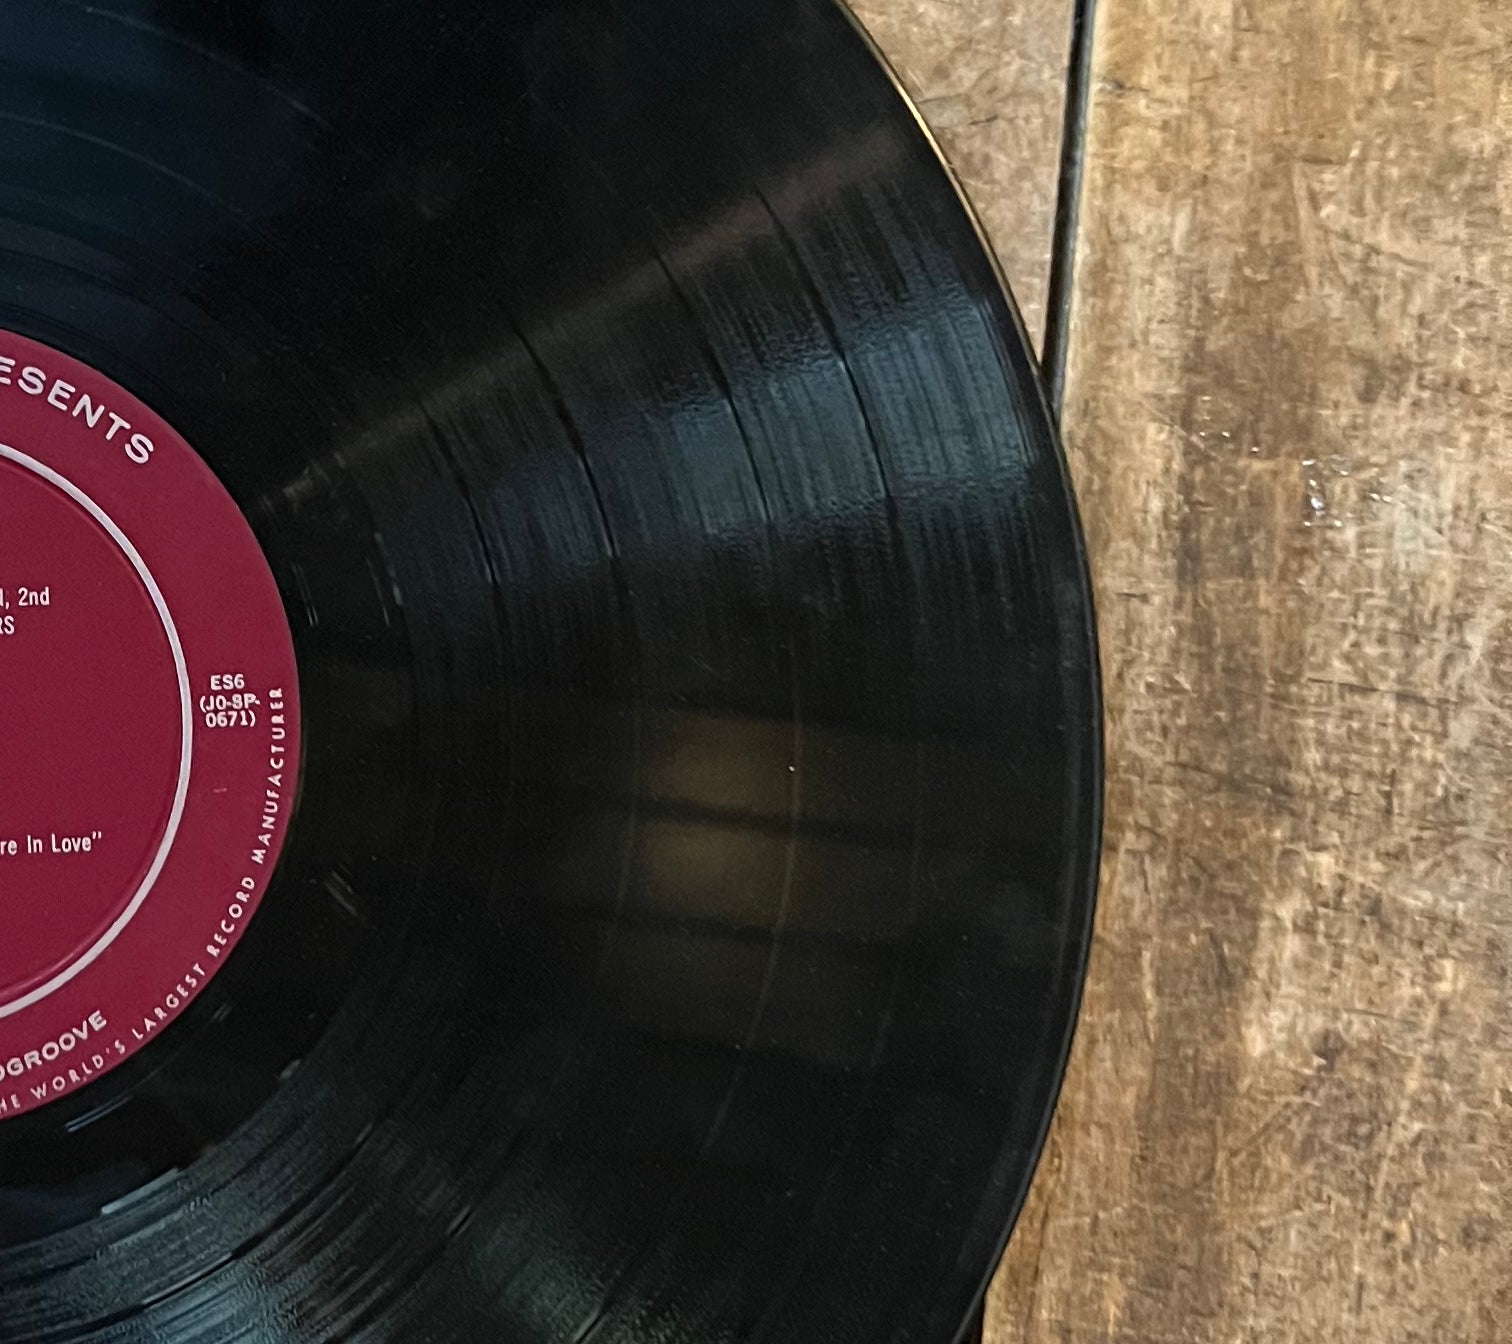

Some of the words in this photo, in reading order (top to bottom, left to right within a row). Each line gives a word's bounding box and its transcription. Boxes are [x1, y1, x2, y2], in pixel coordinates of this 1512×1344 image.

[18, 586, 51, 607] 2nd
[210, 673, 245, 691] ES6
[205, 709, 256, 728] 0671)
[27, 834, 43, 854] In
[30, 1039, 126, 1100] WORLD'S
[132, 962, 206, 1040] LARGEST
[206, 876, 255, 958] RECORD
[250, 687, 286, 865] MANUFACTURER
